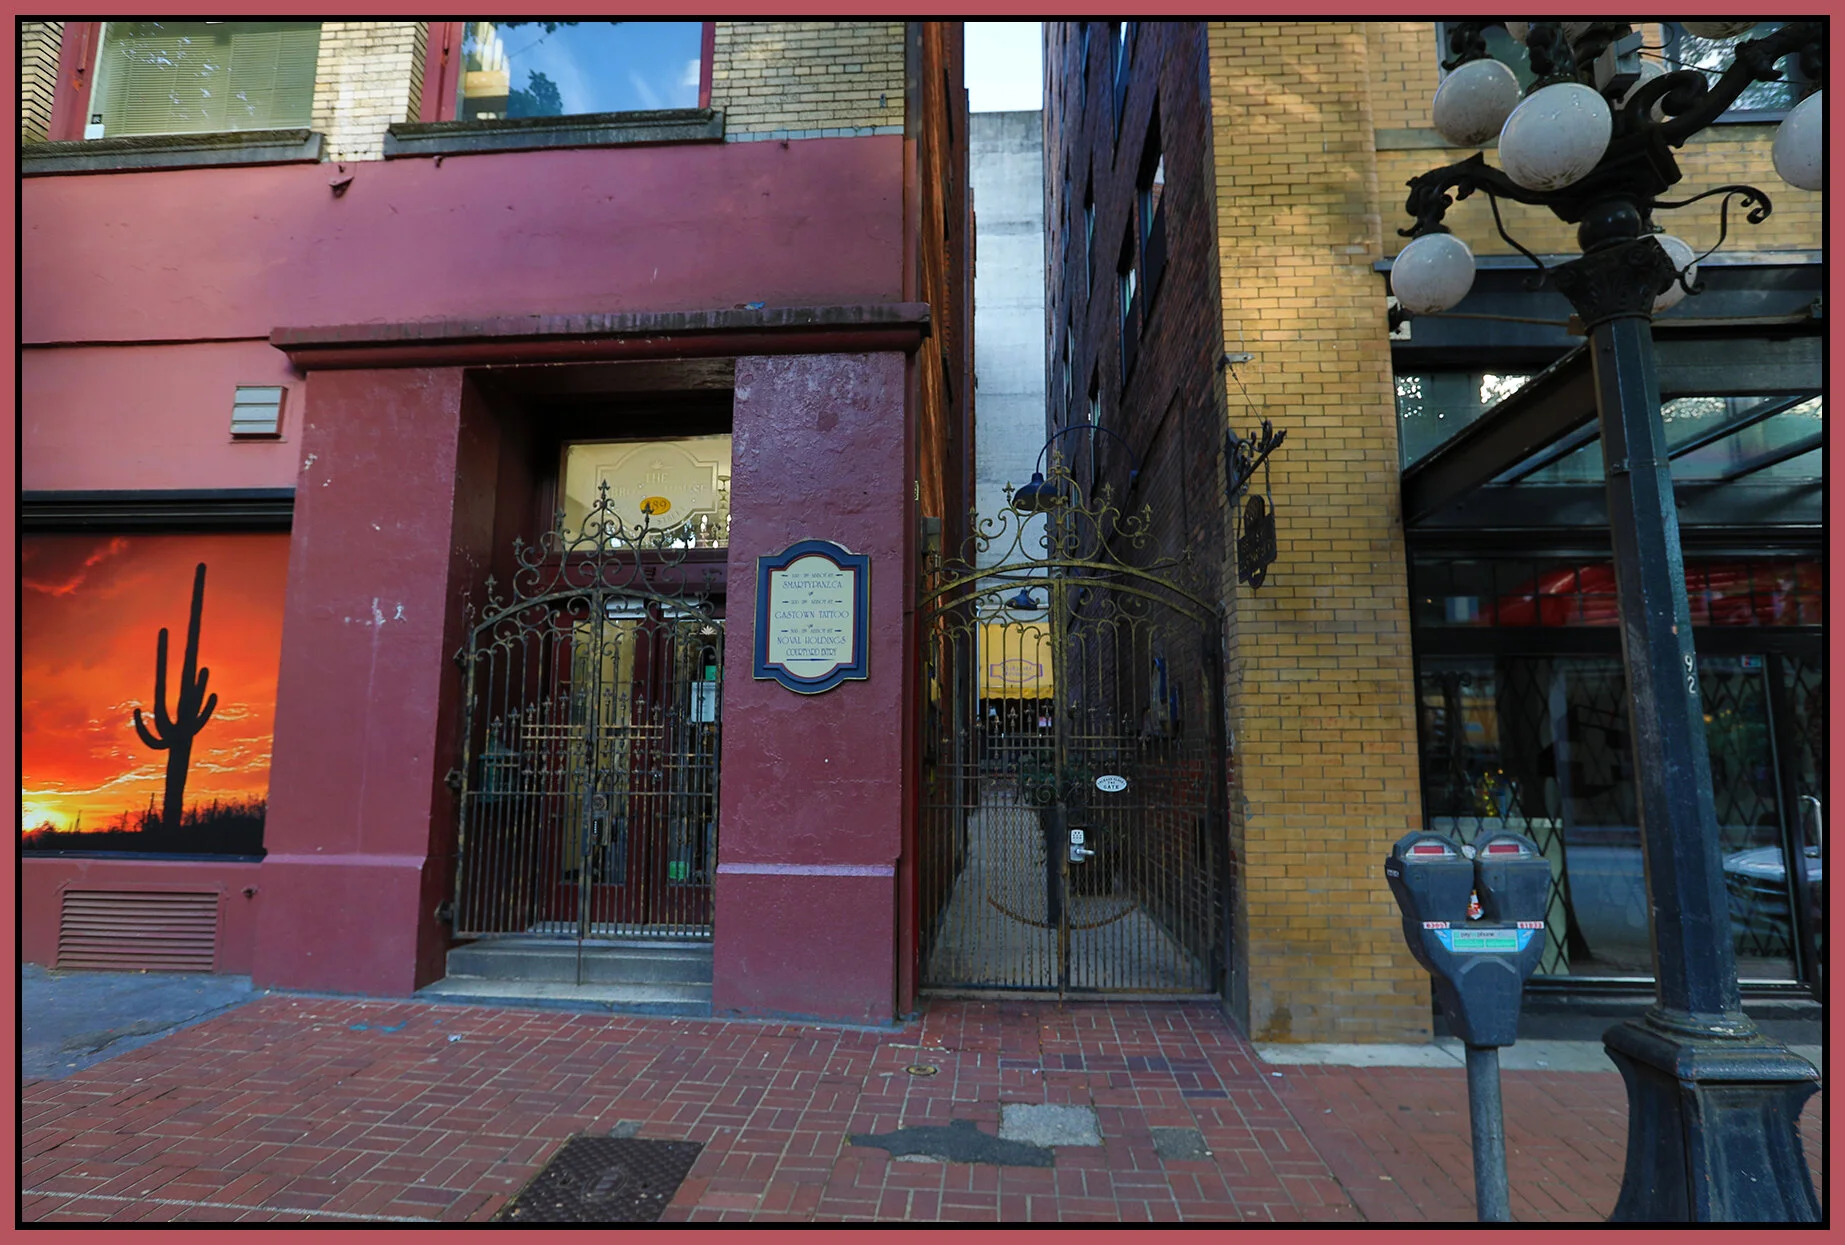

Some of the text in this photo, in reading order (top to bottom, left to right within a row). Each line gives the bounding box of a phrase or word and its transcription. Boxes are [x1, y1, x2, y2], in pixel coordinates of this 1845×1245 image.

[774, 610, 850, 619] GASTOWN TATTOO
[777, 636, 846, 645] NOVAL HOLDINGS
[786, 648, 820, 656] COURTYARD
